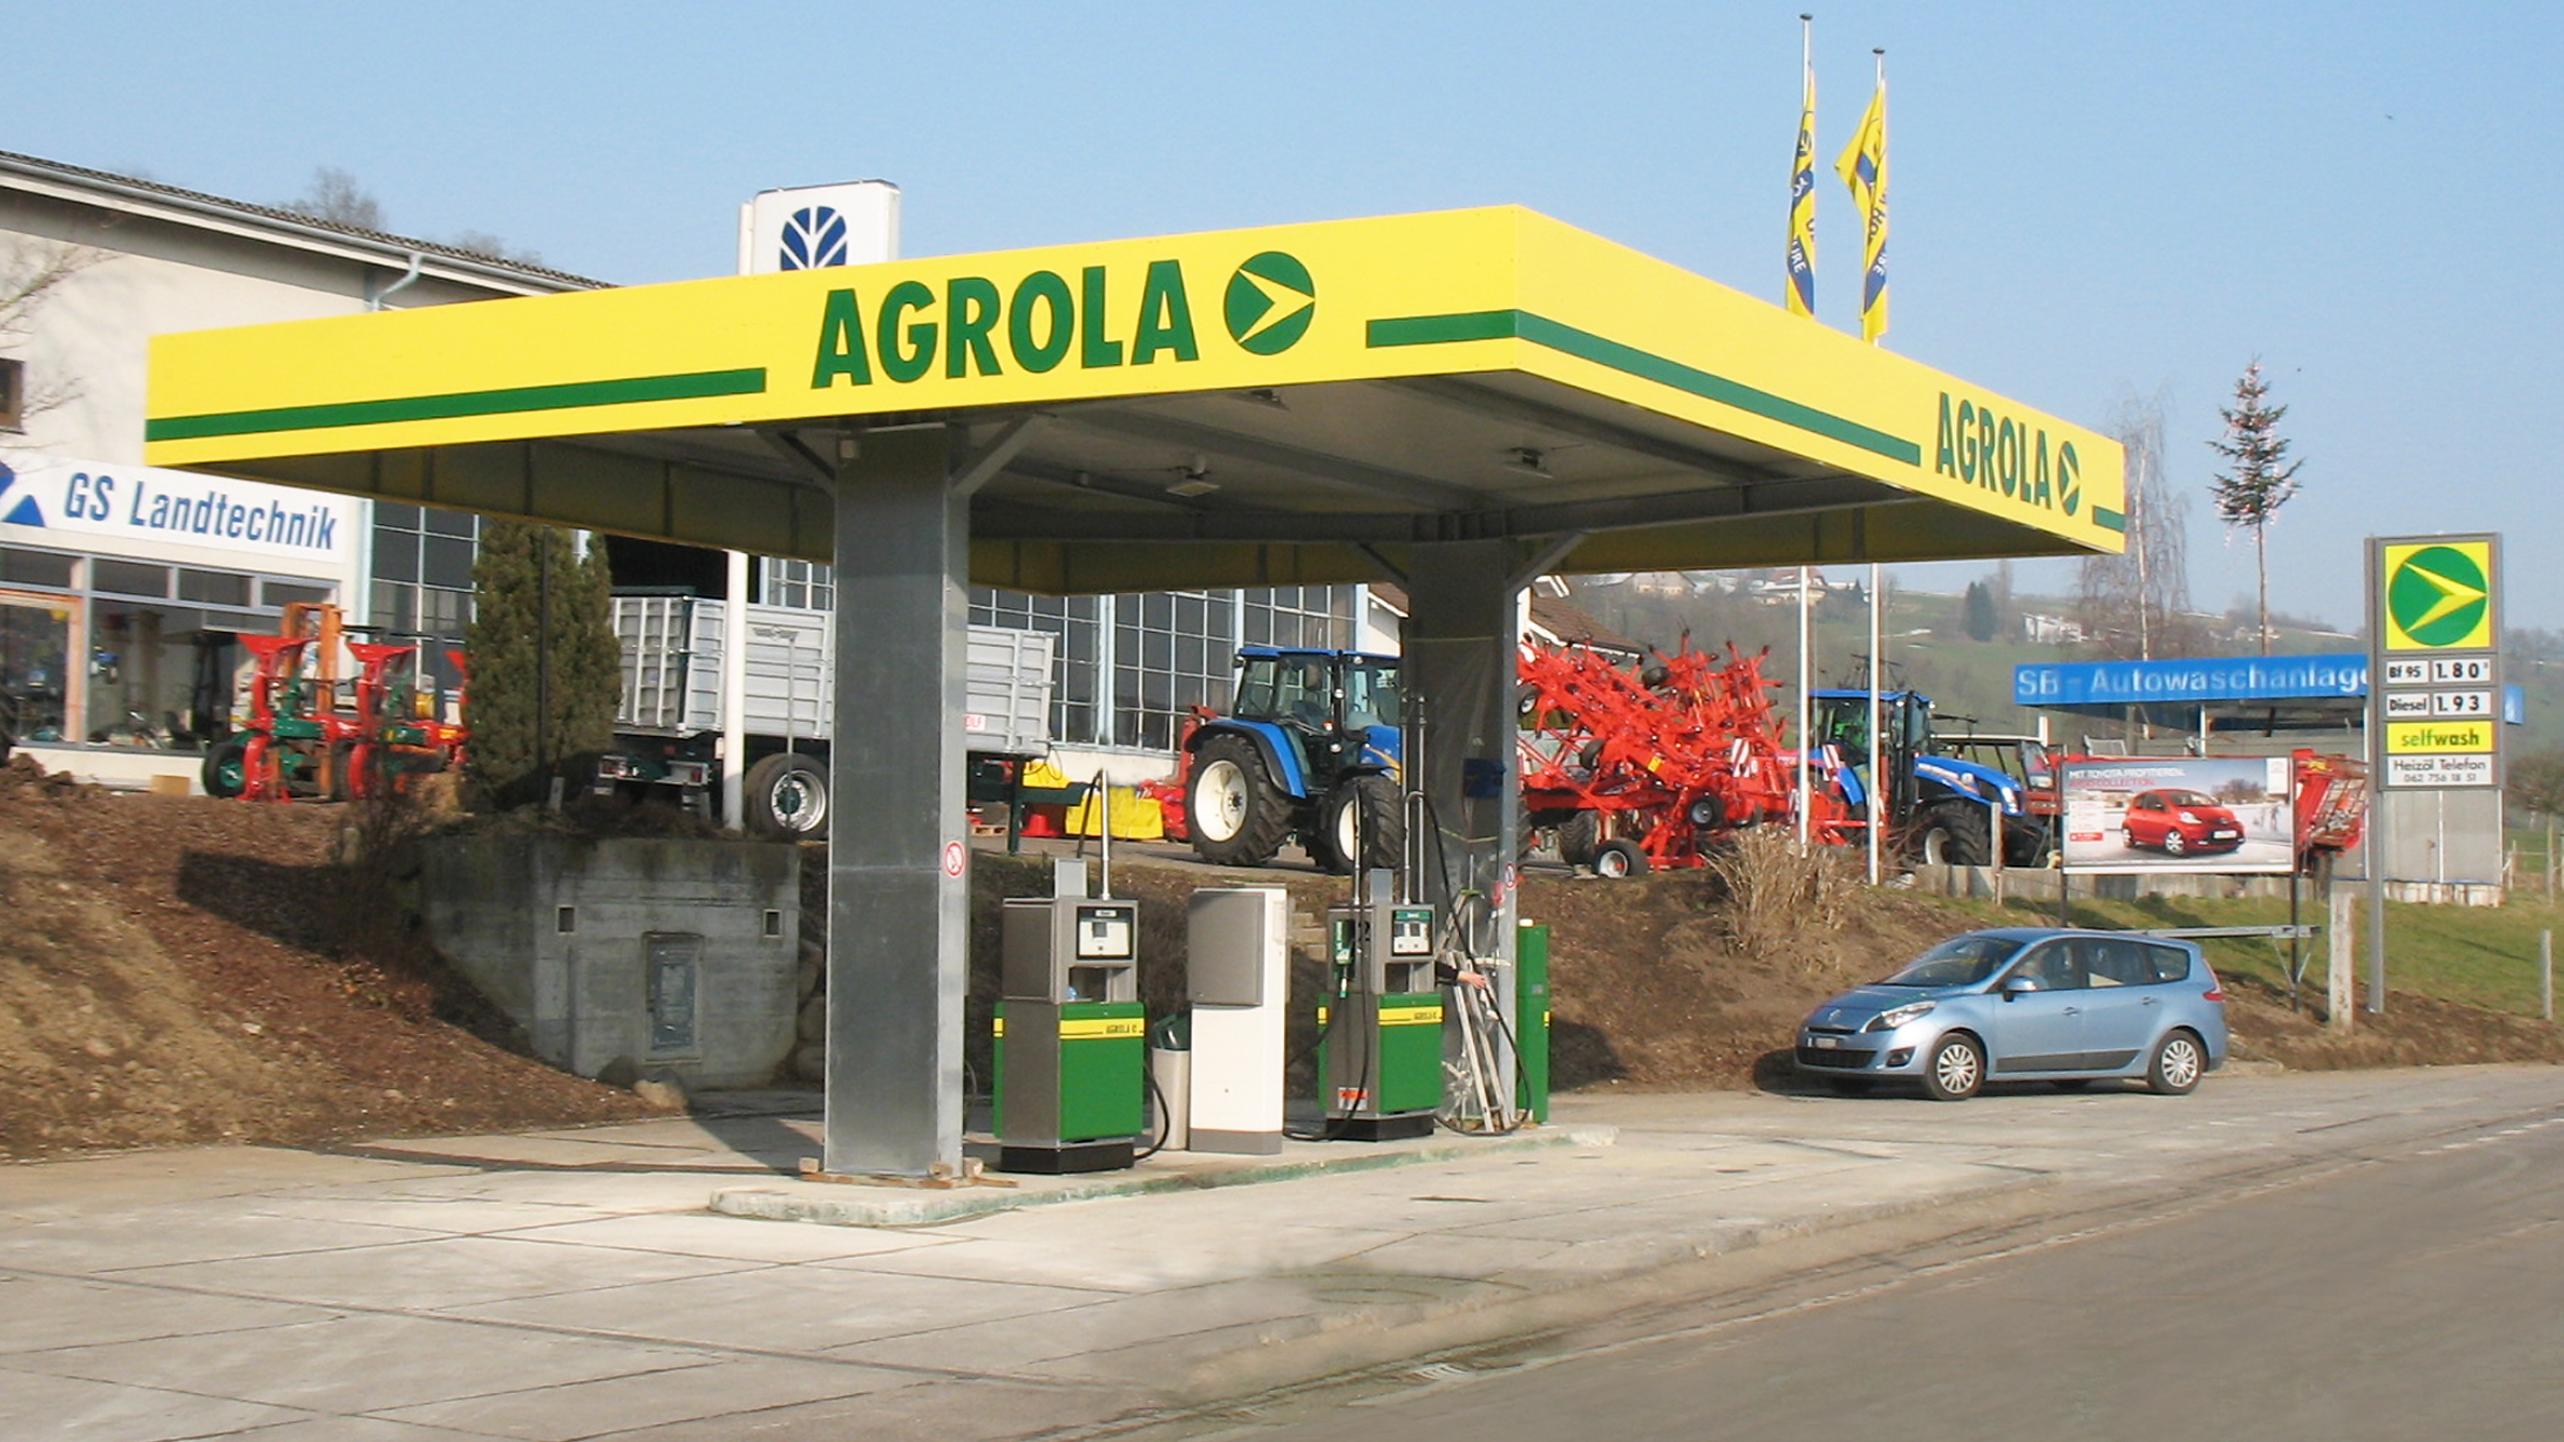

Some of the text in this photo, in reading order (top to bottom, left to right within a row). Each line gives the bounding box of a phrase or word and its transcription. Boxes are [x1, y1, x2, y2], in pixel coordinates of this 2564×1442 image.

[811, 258, 1200, 390] AGROLA
[1935, 391, 2052, 511] AGROLA
[65, 472, 337, 551] GS Landtechnik
[2406, 665, 2421, 678] 95
[2017, 669, 2059, 696] SB
[2389, 698, 2427, 711] Diesel
[2436, 695, 2479, 711] 1.93
[2401, 728, 2479, 747] selfwash
[2394, 757, 2486, 771] Heizöl Telefon
